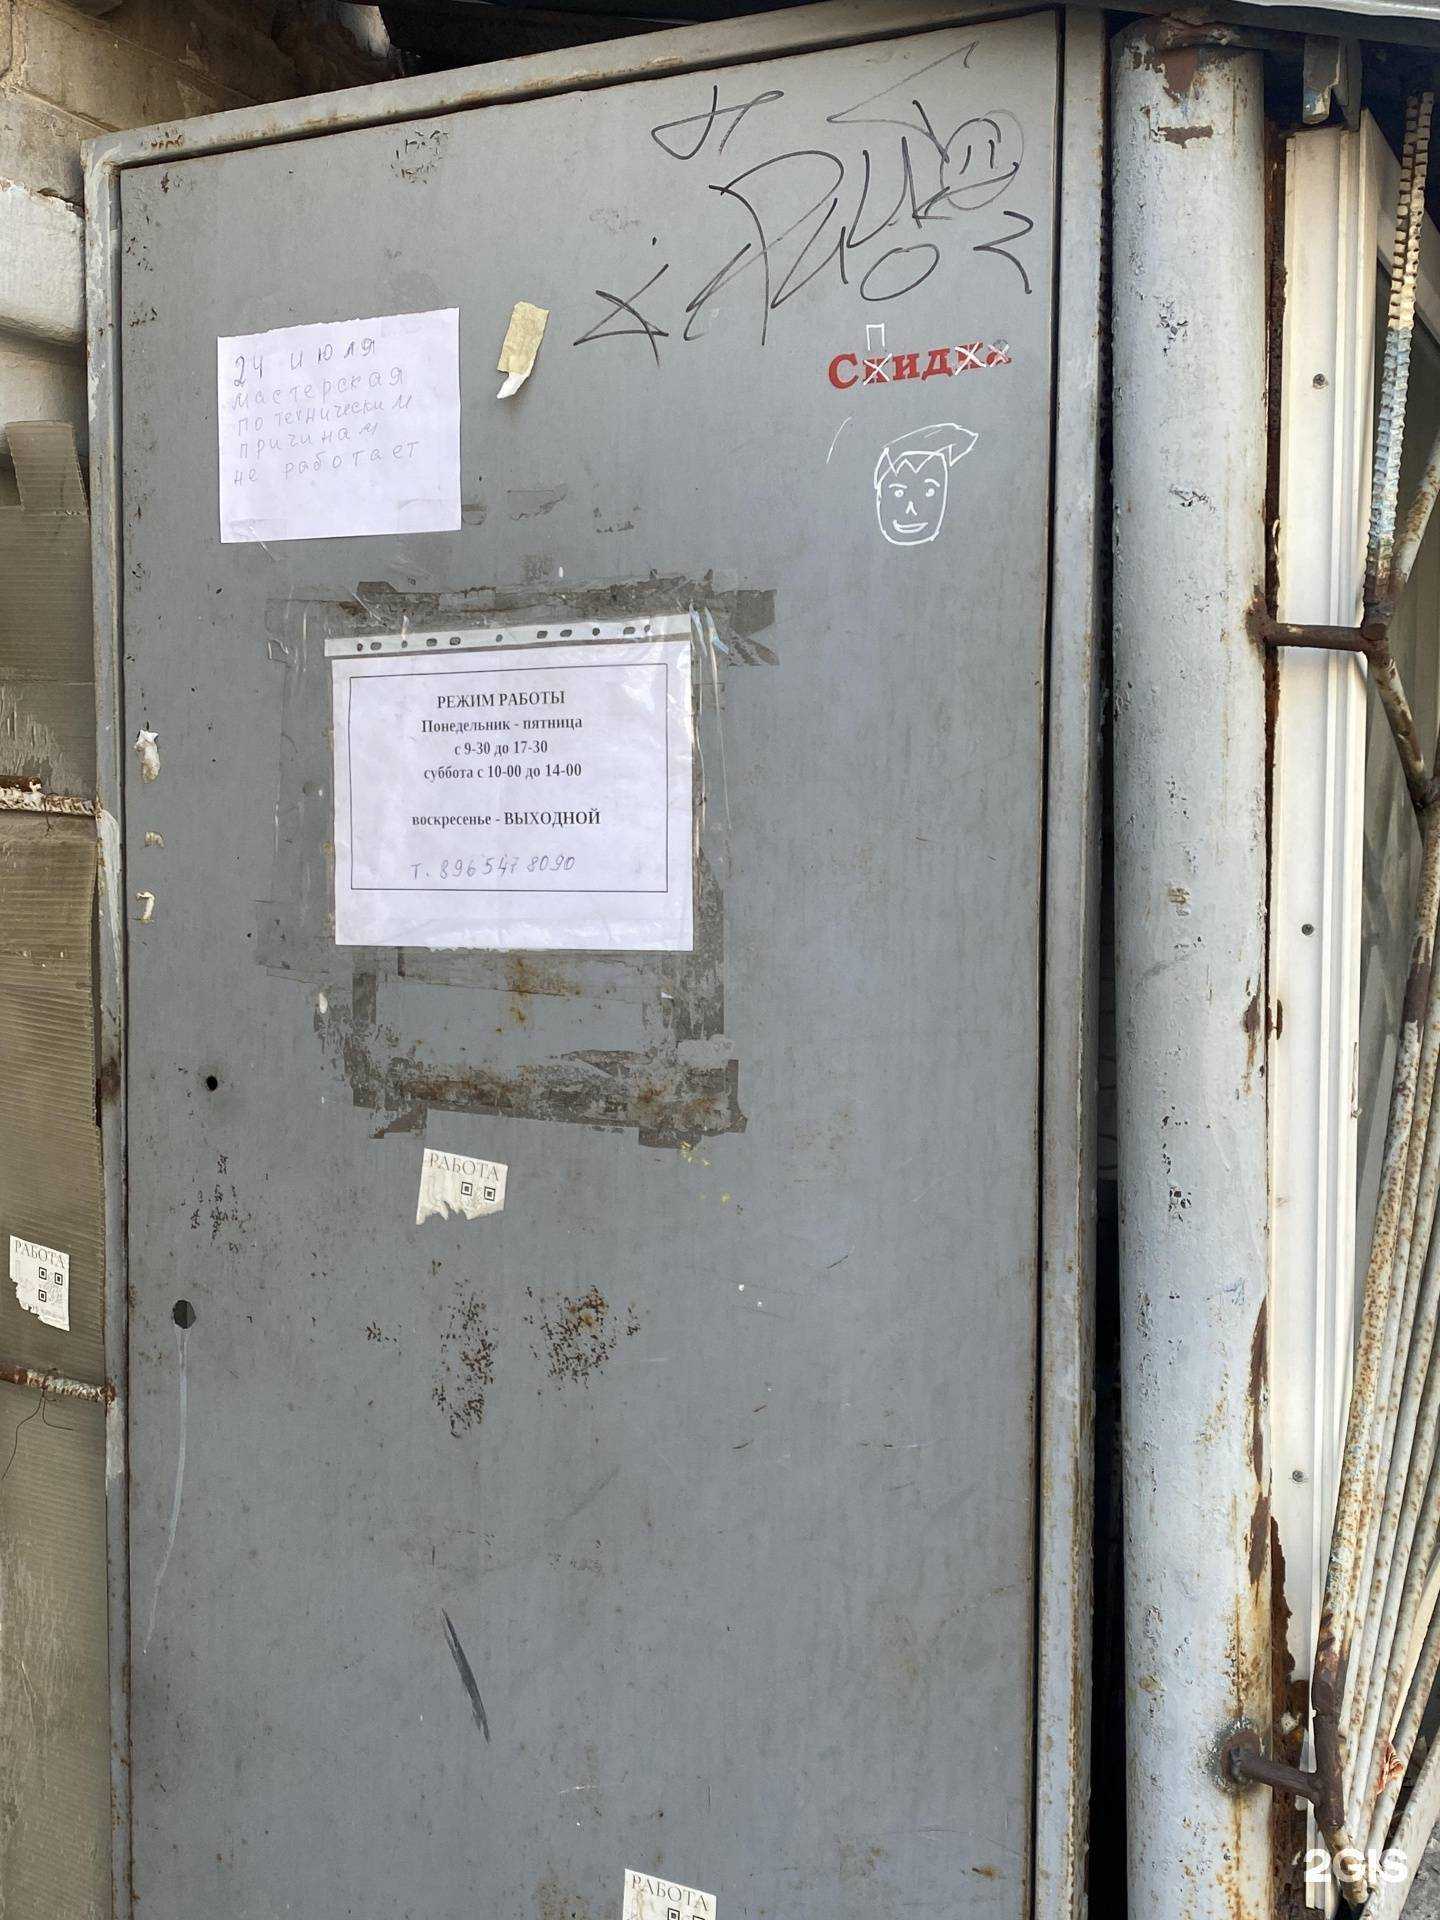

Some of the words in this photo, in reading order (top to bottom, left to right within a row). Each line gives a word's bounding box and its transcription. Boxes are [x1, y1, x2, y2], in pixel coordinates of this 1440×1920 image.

[233, 355, 264, 387] 24
[232, 366, 404, 411] мастерская
[237, 416, 264, 436] по
[239, 421, 379, 460] причинам
[233, 468, 259, 486] не
[283, 441, 420, 481] работает
[437, 693, 495, 709] РЕЖИМ
[499, 690, 566, 707] РАБОТЫ
[421, 719, 511, 733] Понедельник
[523, 717, 583, 731] пятница
[454, 745, 461, 755] с
[464, 742, 491, 755] 9-30
[494, 744, 509, 756] до
[513, 740, 548, 754] 17-30
[424, 766, 473, 783] суббота
[477, 768, 484, 778] с
[488, 765, 522, 777] 10-00
[525, 766, 541, 779] до
[545, 763, 582, 777] 14-00
[412, 814, 492, 828] воскресенье
[504, 808, 601, 829] ВЫХОДНОЙ
[430, 1152, 499, 1182] РАБОТА
[15, 1239, 66, 1270] РАБОТА
[631, 1873, 708, 1912] РАБОТА
